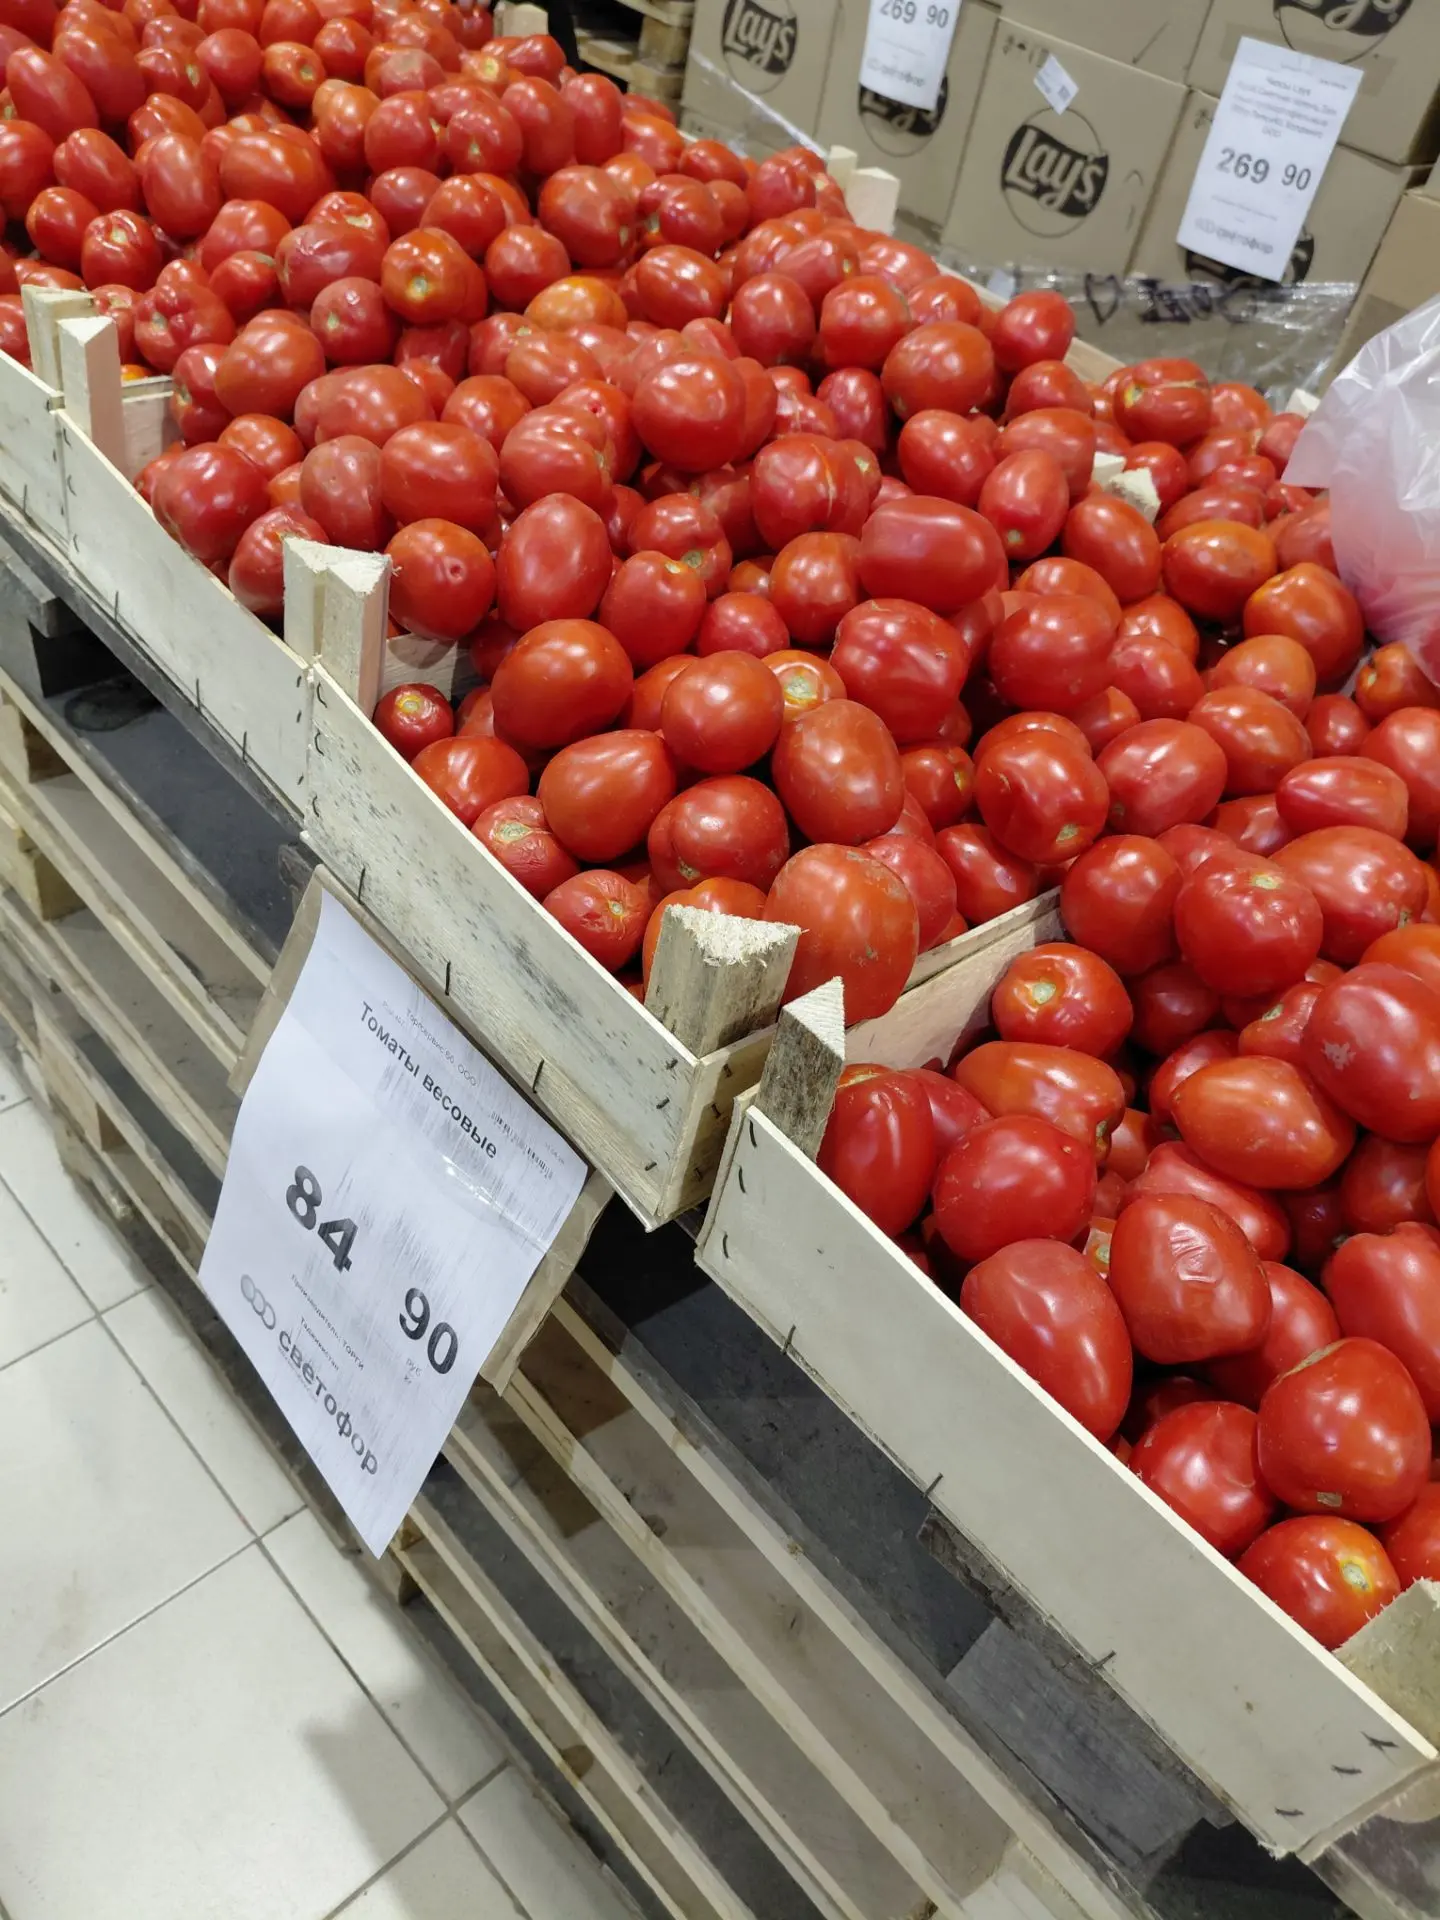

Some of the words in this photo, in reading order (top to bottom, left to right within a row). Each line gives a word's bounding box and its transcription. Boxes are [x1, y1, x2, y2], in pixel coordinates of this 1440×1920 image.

[926, 4, 949, 29] 90
[1004, 128, 1105, 212] Lay's
[1215, 147, 1270, 184] 269
[1281, 163, 1312, 191] 90
[360, 1001, 422, 1078] Томаты
[421, 1073, 498, 1159] весовые
[286, 1165, 358, 1273] 84
[400, 1287, 458, 1374] 90
[342, 1338, 364, 1372] ТОРГИ
[278, 1330, 379, 1475] светофор
